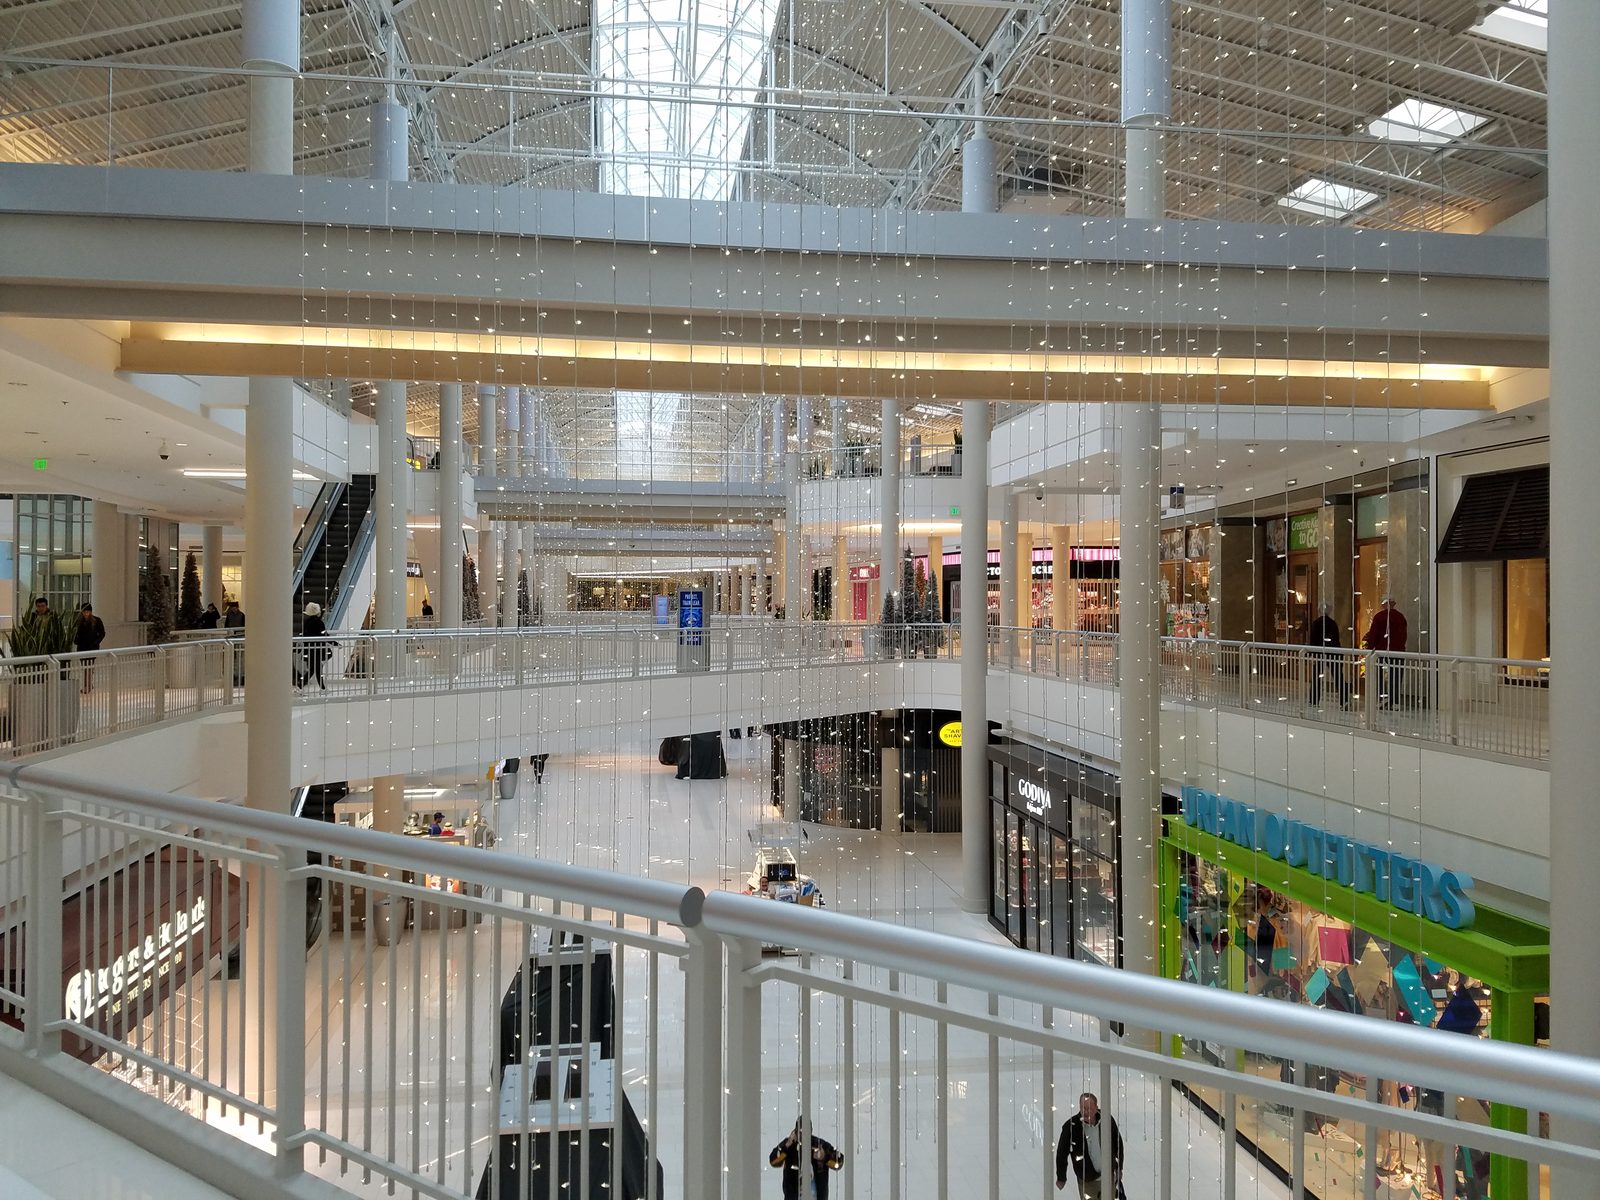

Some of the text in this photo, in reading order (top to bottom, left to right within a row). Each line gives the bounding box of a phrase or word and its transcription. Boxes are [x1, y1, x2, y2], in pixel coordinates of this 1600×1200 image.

[1299, 528, 1318, 548] to GO
[1019, 779, 1051, 808] GODIVA
[1181, 784, 1476, 930] URBAN OUTFITTERS
[143, 935, 156, 960] &
